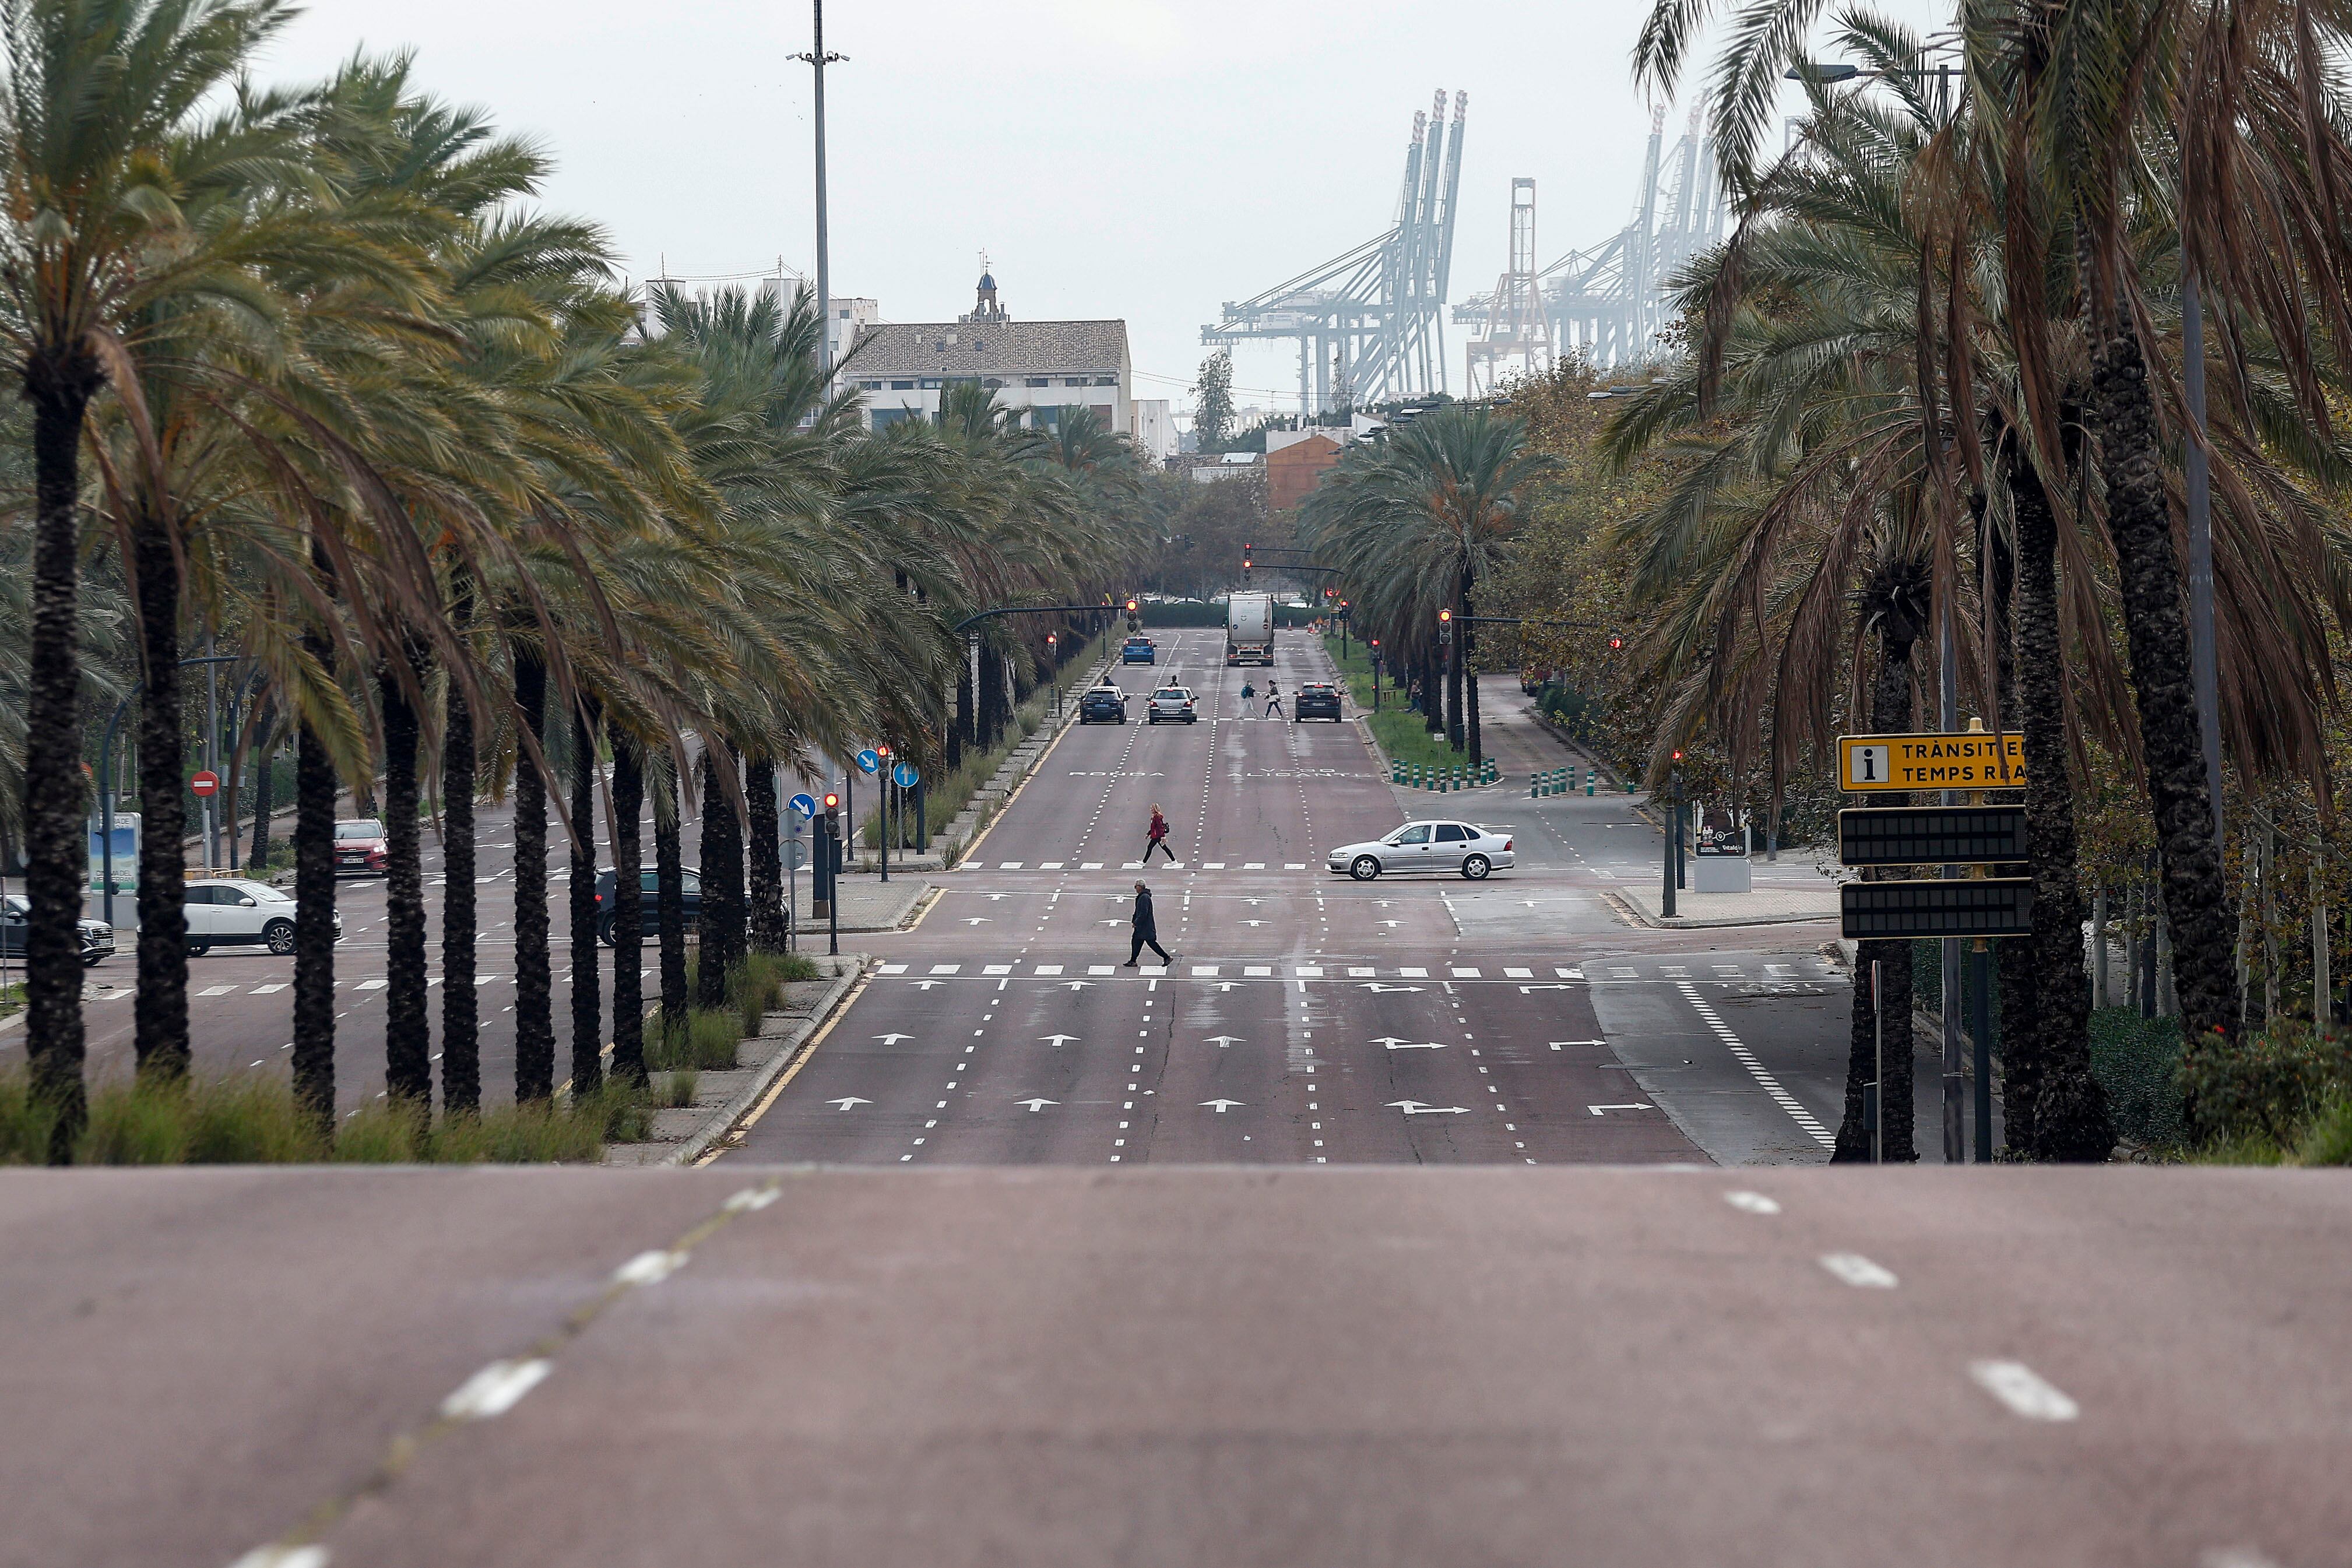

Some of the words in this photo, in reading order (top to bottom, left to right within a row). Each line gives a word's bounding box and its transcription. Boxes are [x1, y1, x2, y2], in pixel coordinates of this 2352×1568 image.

[1902, 740, 1996, 758] TRÀNSIT
[2007, 741, 2025, 756] E
[1903, 766, 1974, 782] TEMPS
[1984, 765, 2027, 780] RA
